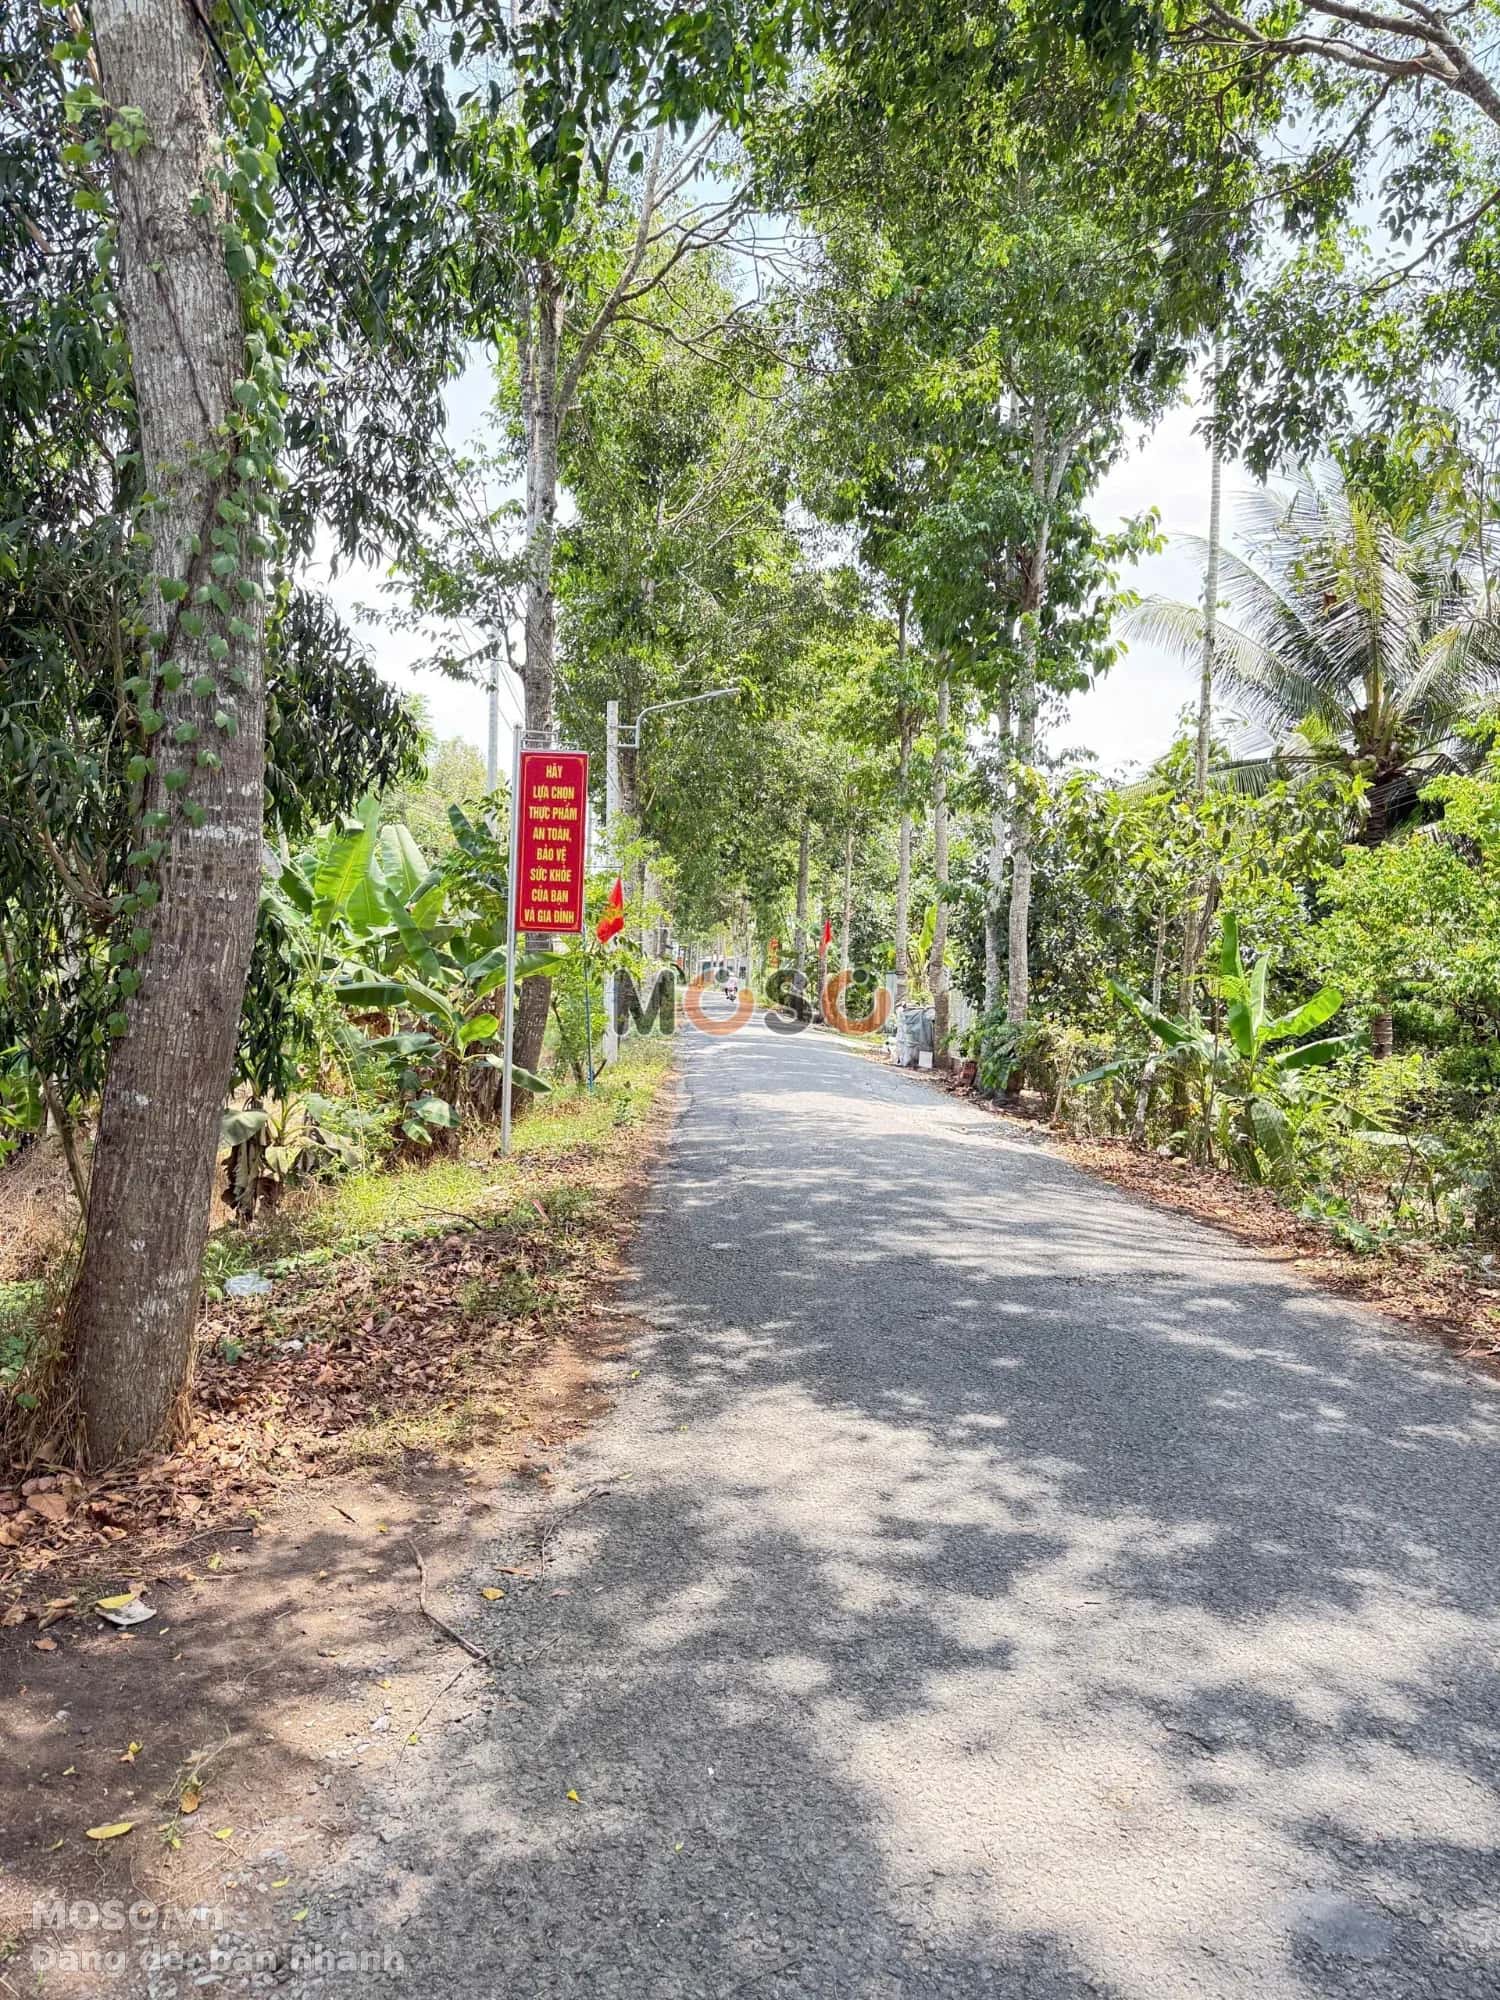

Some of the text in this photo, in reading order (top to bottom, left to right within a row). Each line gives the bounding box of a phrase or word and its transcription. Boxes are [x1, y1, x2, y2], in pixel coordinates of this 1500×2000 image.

[546, 763, 563, 779] HÃY
[533, 784, 575, 802] LỰA CHỌN
[529, 802, 578, 822] THỰC PHẨM
[533, 826, 545, 840] AN
[537, 843, 567, 865] BẢO VỆ
[530, 865, 572, 882] SỨC KHỎE
[532, 884, 569, 905] CỦA BẠN
[524, 907, 575, 924] VÀ GIA ĐÌNH
